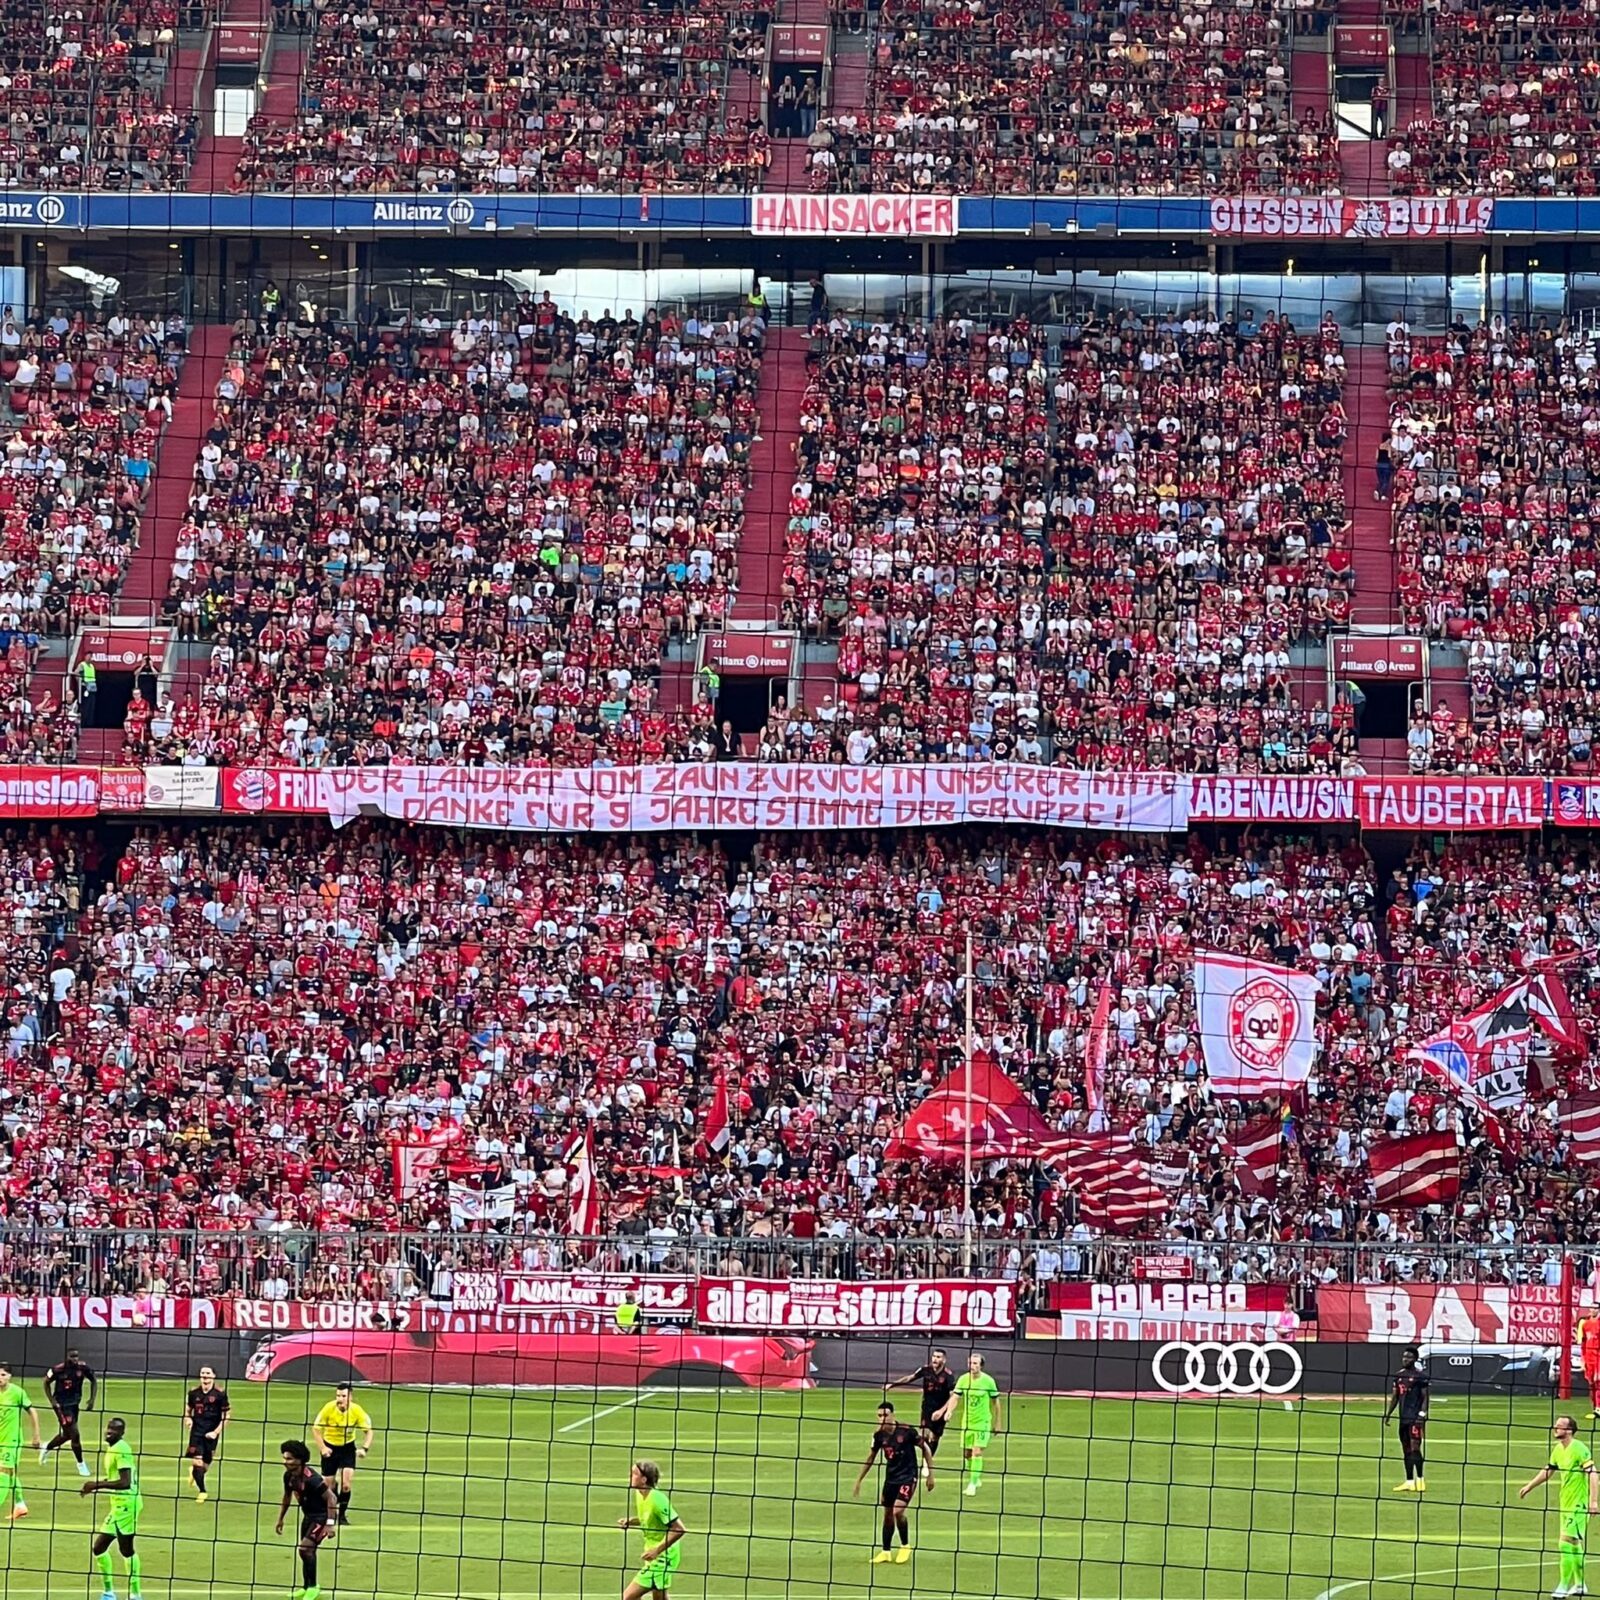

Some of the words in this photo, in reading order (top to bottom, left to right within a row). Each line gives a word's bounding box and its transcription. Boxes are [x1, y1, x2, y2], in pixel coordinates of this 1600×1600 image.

[374, 202, 443, 220] Allianz
[756, 197, 952, 232] HAINSACKER
[1210, 198, 1344, 234] GIESSEN
[1388, 198, 1494, 235] BULLS
[712, 639, 727, 648] 222
[713, 656, 744, 666] llianz
[760, 657, 787, 666] Arena
[1340, 661, 1373, 671] Allianz
[1388, 661, 1416, 671] Arena
[331, 770, 403, 793] DER
[417, 769, 563, 796] LANDRAT
[574, 769, 643, 799] VOM
[652, 767, 739, 792] ZAUN
[892, 769, 926, 794] IN
[1093, 773, 1178, 796] MITTE
[403, 796, 515, 825] DANKE
[526, 802, 595, 828] FÜR
[609, 802, 630, 828] 9
[650, 796, 758, 825] JAHRE
[766, 797, 881, 826] STIMME
[896, 800, 955, 824] DER
[1362, 785, 1543, 825] TAUBERTAL
[453, 1272, 497, 1287] SEEN
[453, 1286, 498, 1300] LAND
[1510, 1284, 1580, 1303] ULTRS
[453, 1299, 497, 1311] FRONT
[951, 1285, 1013, 1327] rot
[235, 1300, 290, 1328] RED
[300, 1300, 411, 1331] COBRAS
[1075, 1319, 1129, 1341] RED
[900, 1484, 910, 1496] 42
